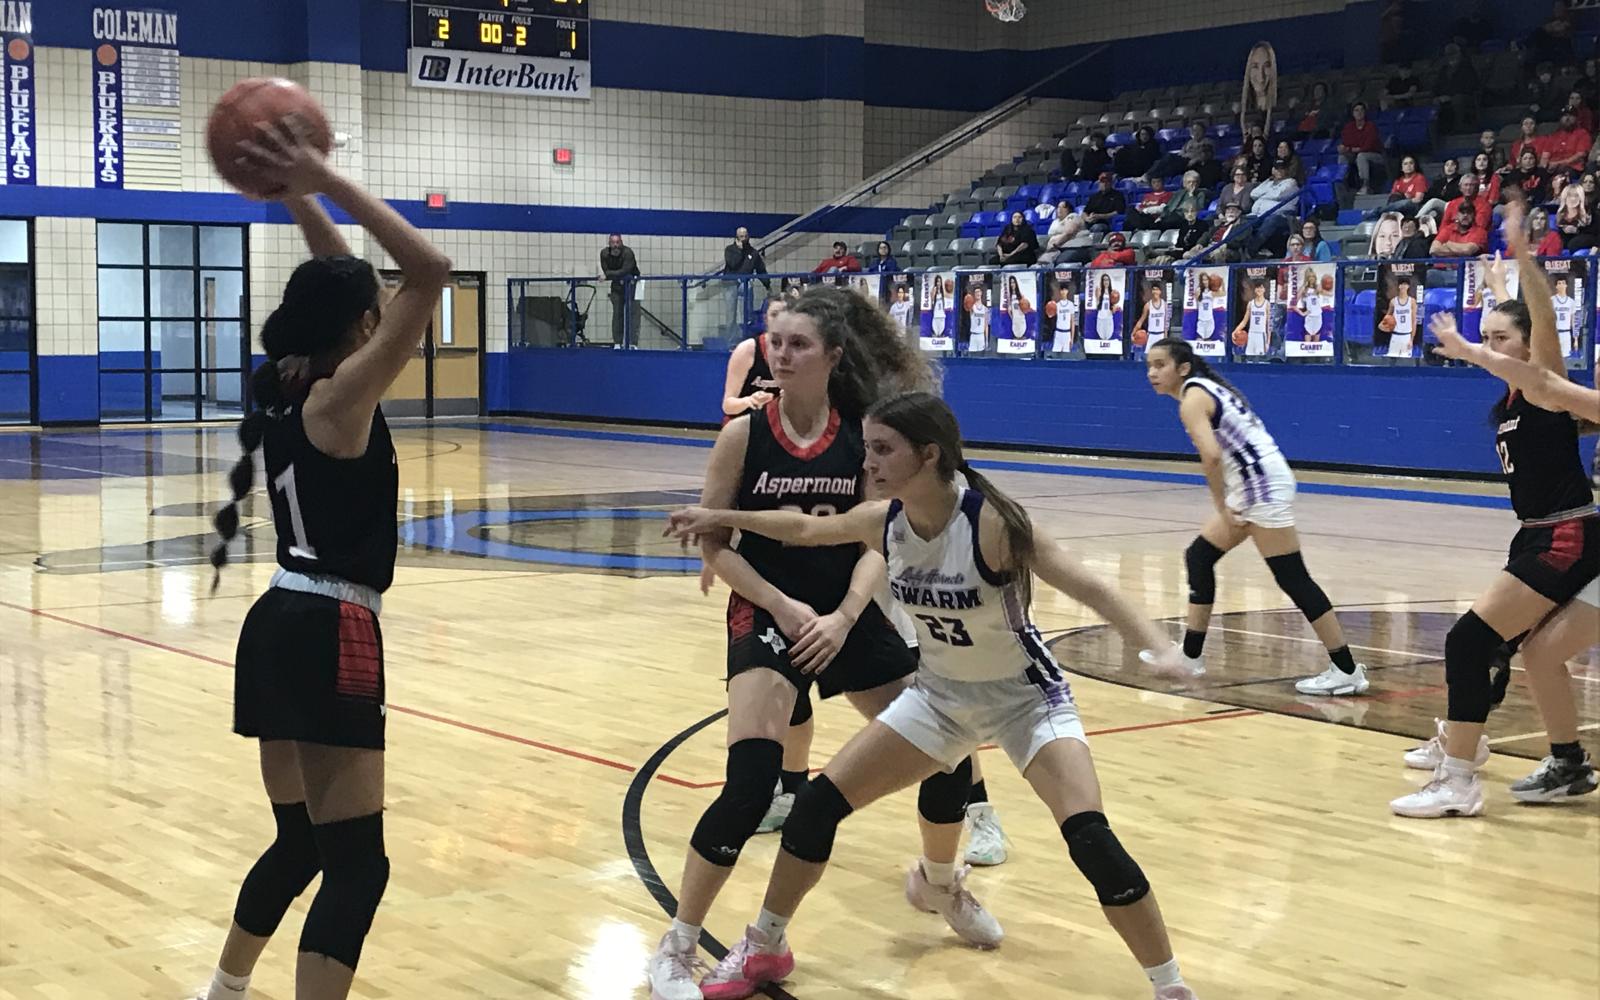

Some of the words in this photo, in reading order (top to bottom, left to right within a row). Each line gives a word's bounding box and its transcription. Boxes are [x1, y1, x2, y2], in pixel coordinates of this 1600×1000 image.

[93, 8, 178, 45] COLEMAN
[428, 8, 449, 18] FOULS
[478, 13, 505, 22] PLAYER
[511, 14, 532, 26] FOULS
[556, 20, 576, 30] FOULS
[438, 19, 450, 40] 2
[480, 23, 502, 44] 00
[515, 26, 527, 46] 2
[570, 31, 577, 50] 1
[456, 57, 581, 92] InterBank
[10, 65, 31, 179] BLUECATS
[97, 71, 119, 183] BLUEKATS
[274, 461, 319, 559] 1
[890, 580, 985, 609] SWARM
[914, 613, 974, 646] 23
